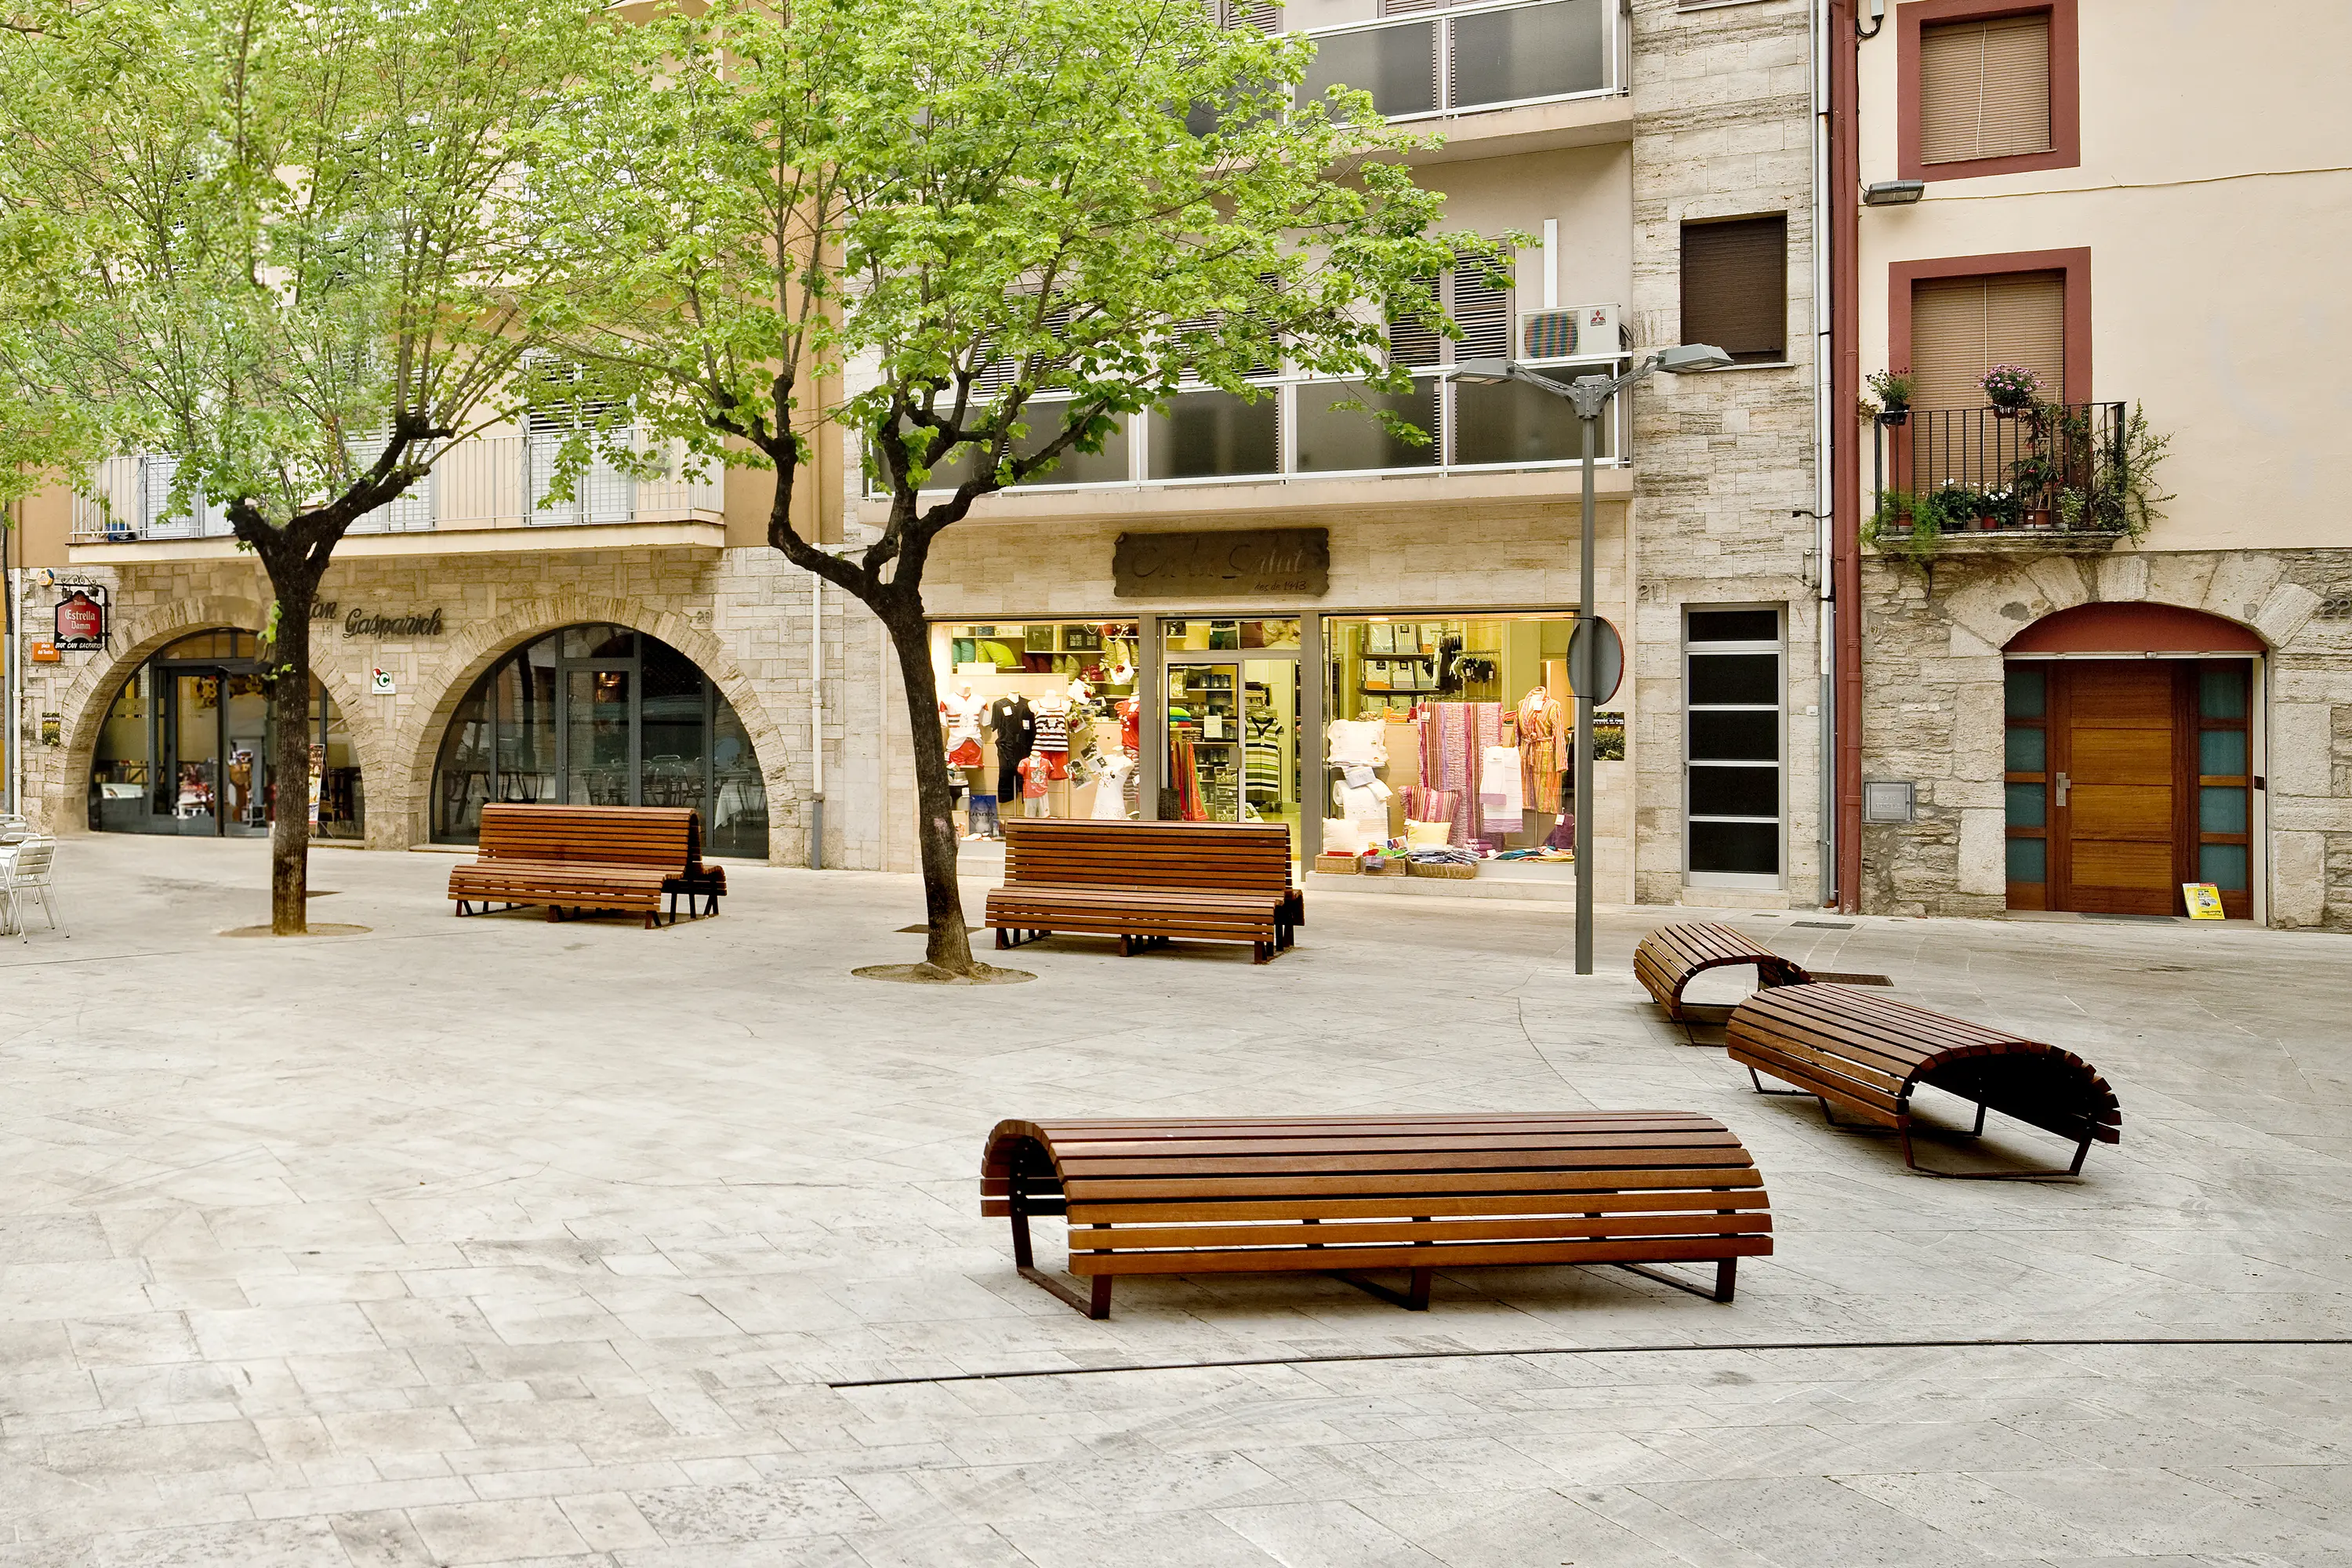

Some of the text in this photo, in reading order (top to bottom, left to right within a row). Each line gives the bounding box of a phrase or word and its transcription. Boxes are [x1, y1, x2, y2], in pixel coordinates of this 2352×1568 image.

[1638, 584, 1658, 601] 21
[65, 609, 95, 620] Estrella
[2321, 598, 2351, 618] 22
[71, 621, 91, 630] Damm
[343, 608, 441, 639] Gasparich
